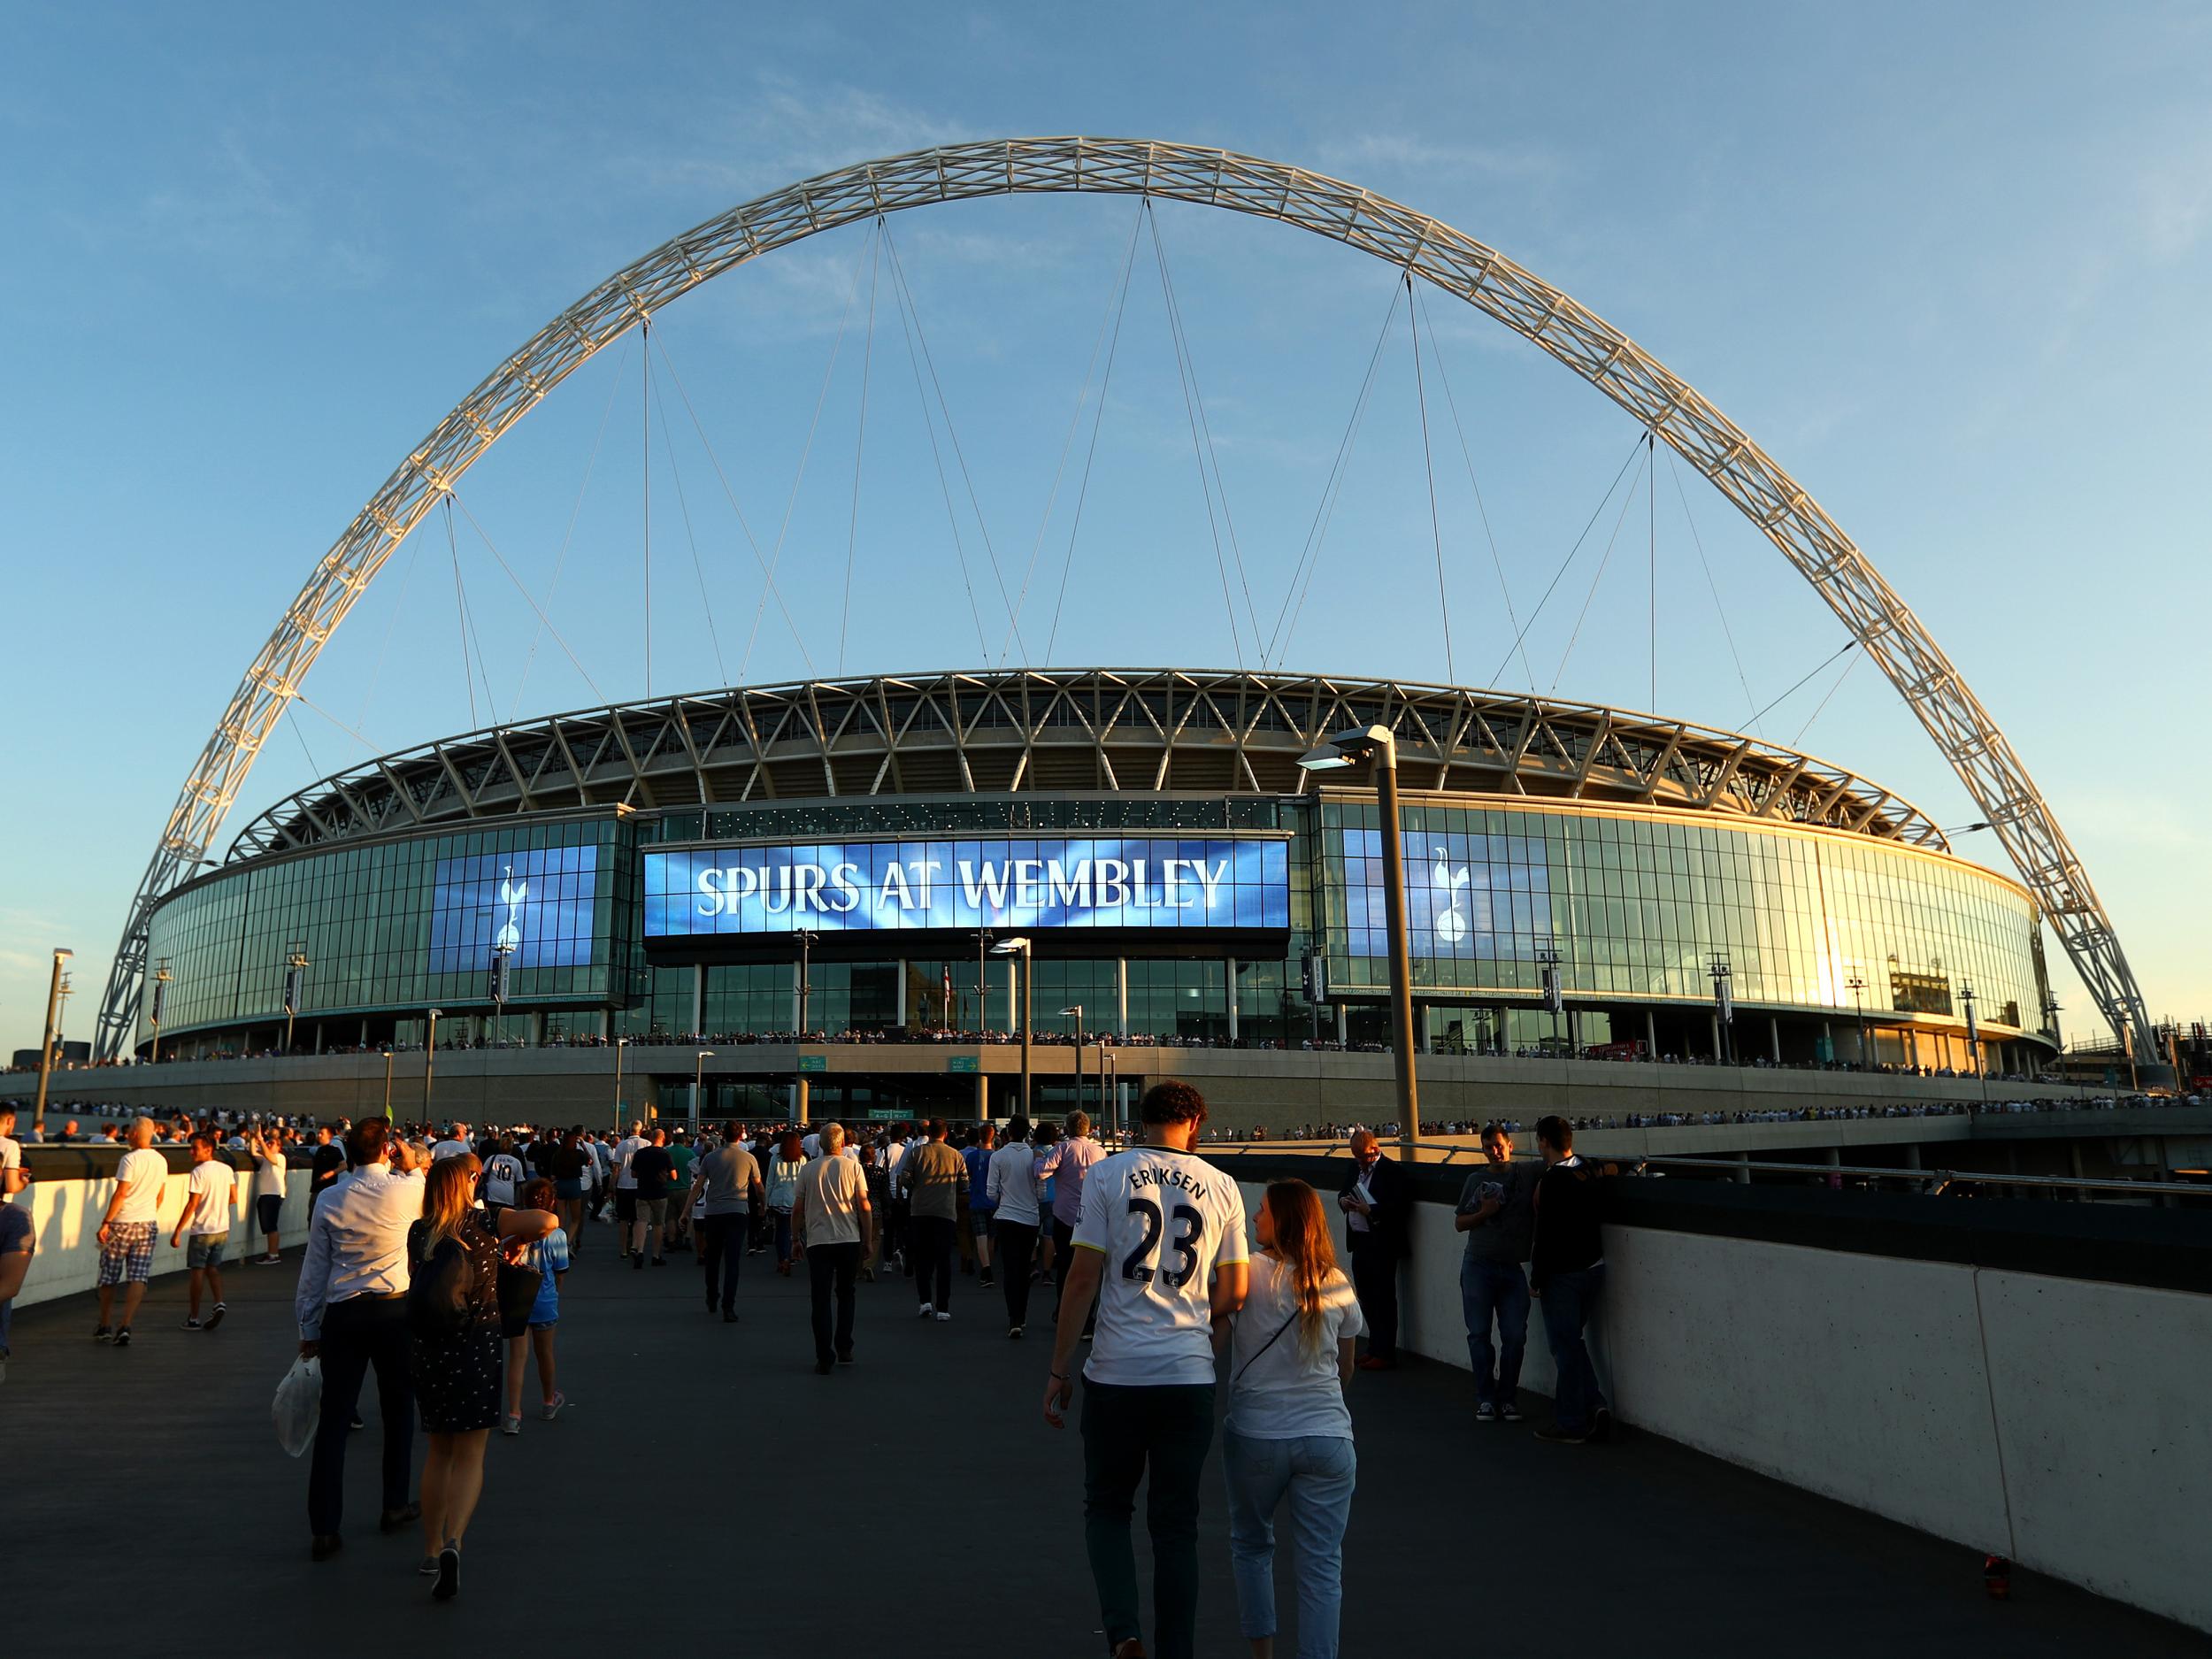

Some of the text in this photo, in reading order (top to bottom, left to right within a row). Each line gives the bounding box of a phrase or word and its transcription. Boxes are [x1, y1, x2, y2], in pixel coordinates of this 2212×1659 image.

[697, 859, 1229, 917] SPURS AT WEMBLEY
[497, 1163, 512, 1182] 10
[1128, 1167, 1206, 1201] ERIKSEN
[1122, 1197, 1203, 1288] 23
